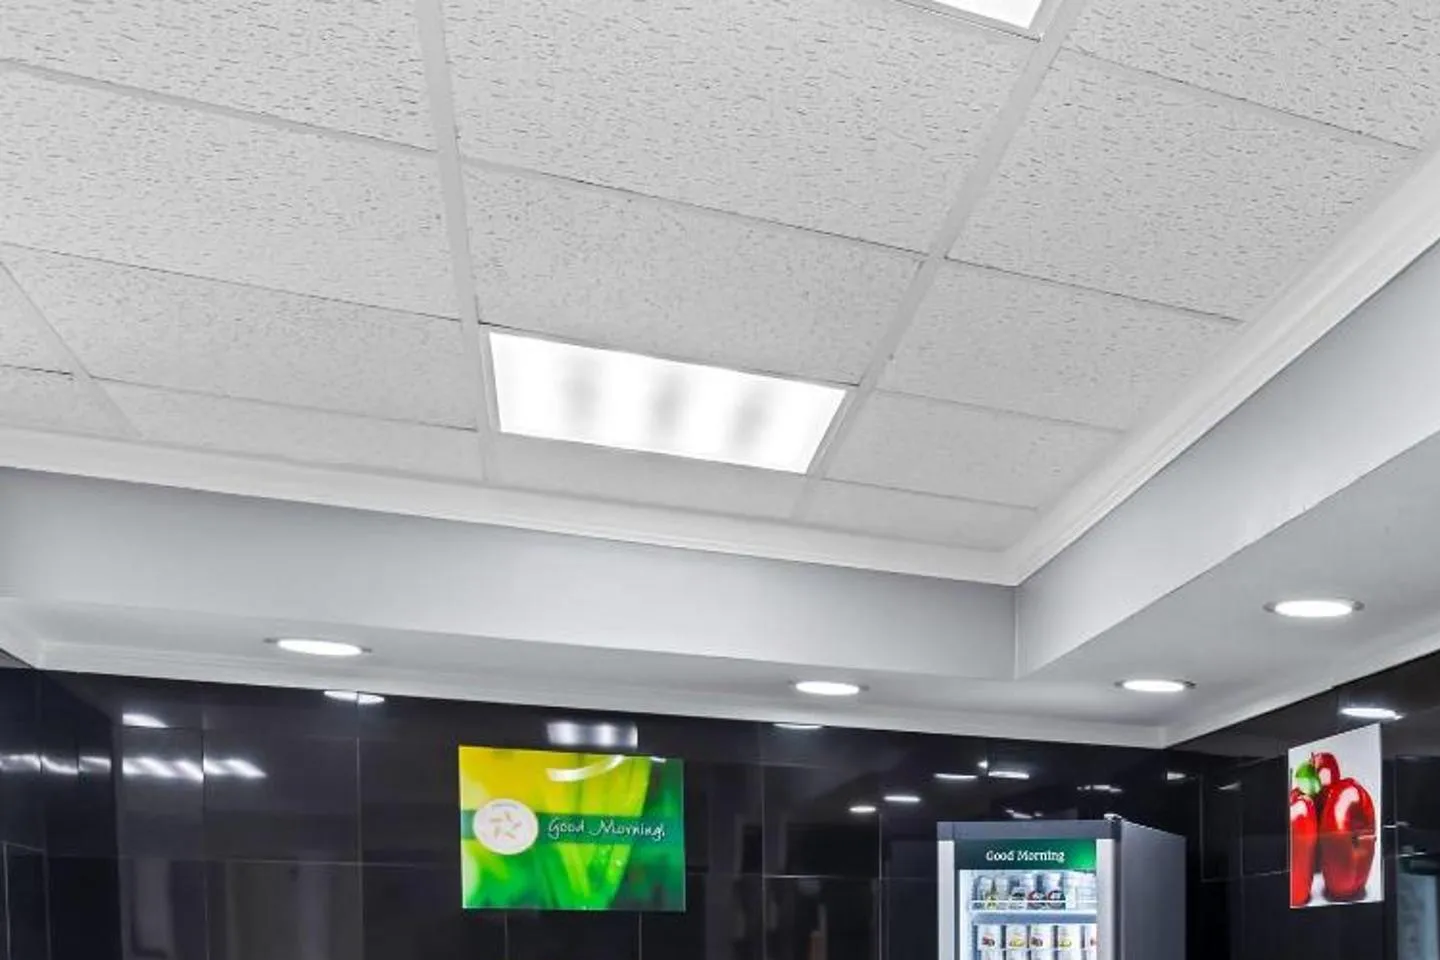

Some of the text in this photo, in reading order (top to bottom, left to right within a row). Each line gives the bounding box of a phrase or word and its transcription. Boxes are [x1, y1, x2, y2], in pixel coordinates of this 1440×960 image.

[548, 817, 585, 840] Good
[986, 849, 1064, 863] Good Morning
